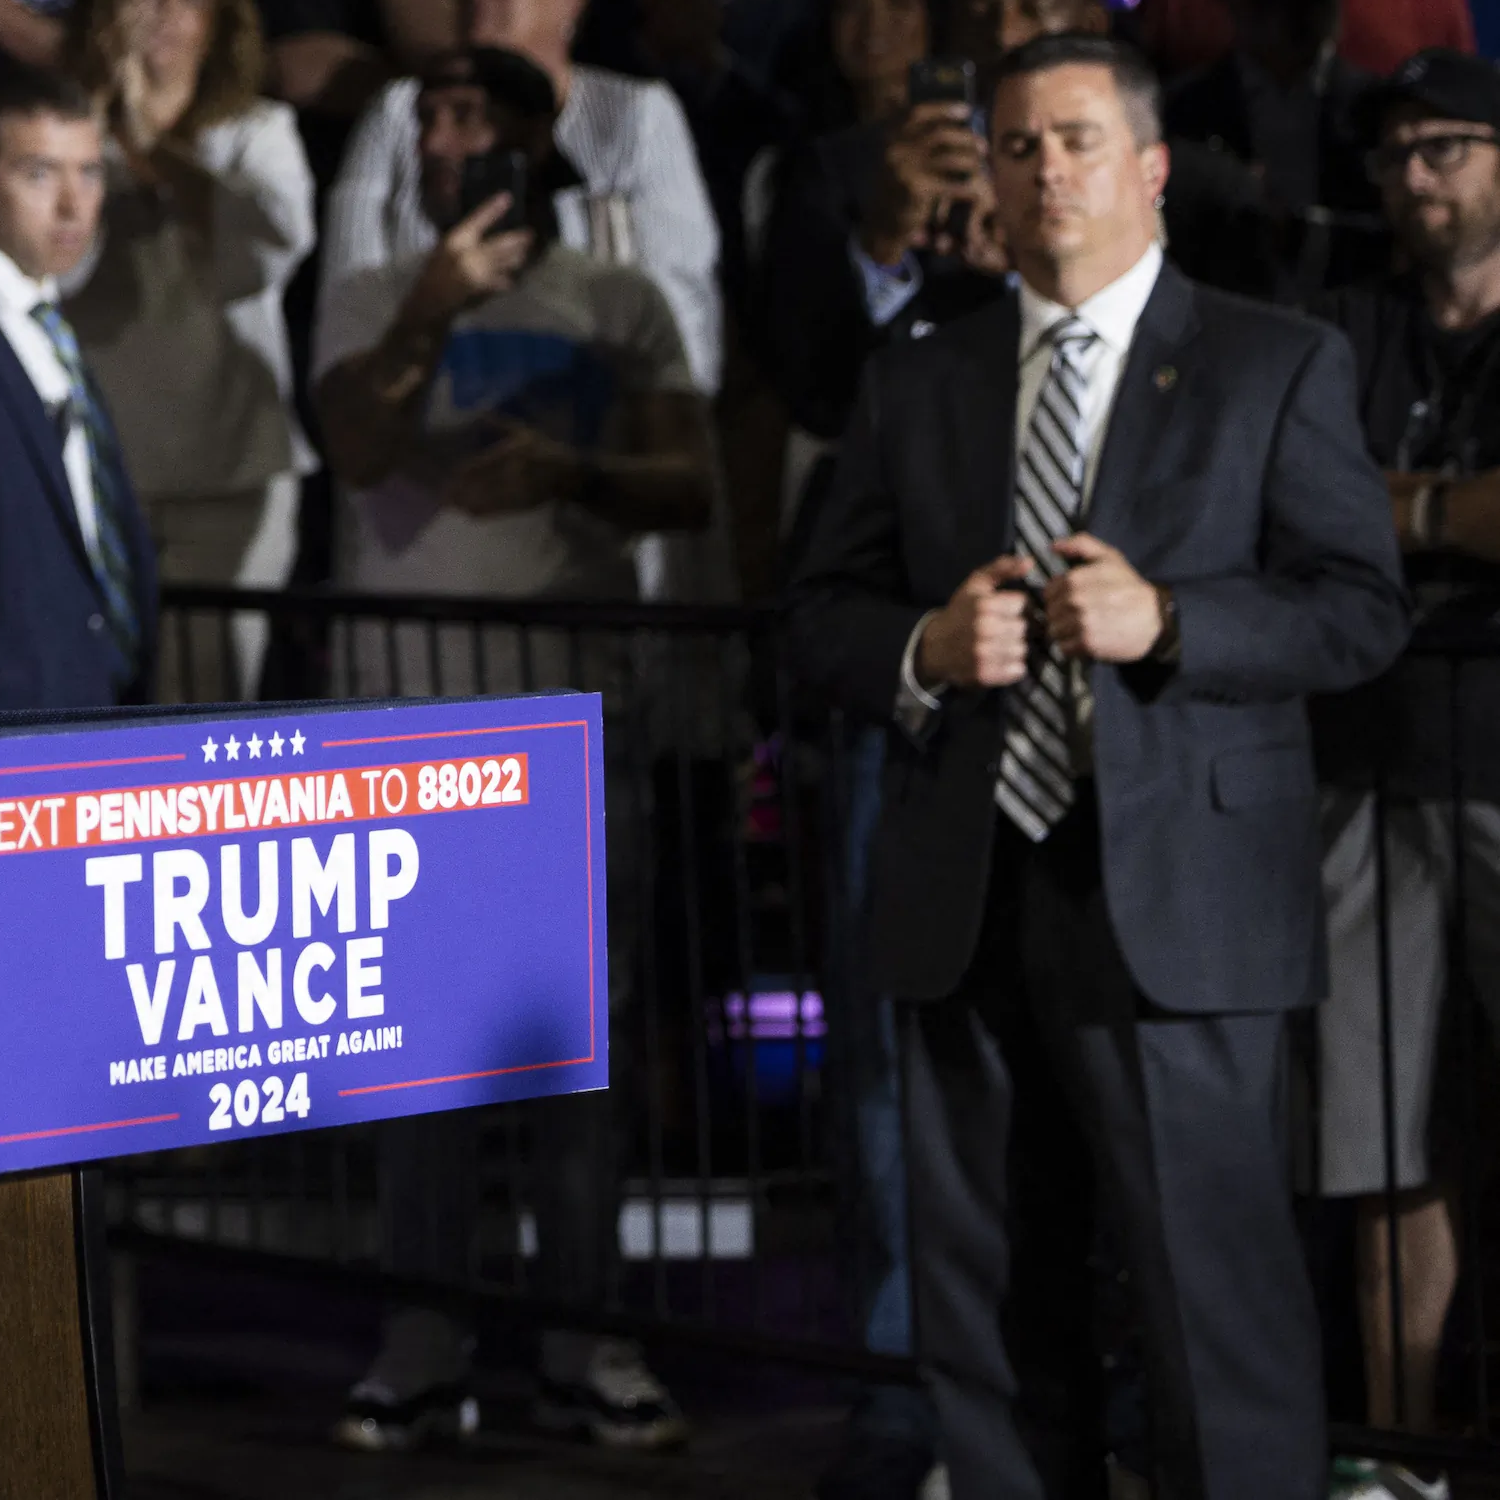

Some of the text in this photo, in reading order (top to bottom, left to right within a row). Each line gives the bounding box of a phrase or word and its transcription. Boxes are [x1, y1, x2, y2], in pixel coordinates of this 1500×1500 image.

[76, 772, 353, 844] PENNSYLVANIA
[361, 767, 408, 815] TO
[416, 757, 522, 811] 88022
[85, 828, 420, 960] TRUMP
[125, 936, 385, 1046] VANCE
[109, 1025, 403, 1086] MAKE AMERICA GREAT AGAIN!
[208, 1071, 311, 1131] 2024
